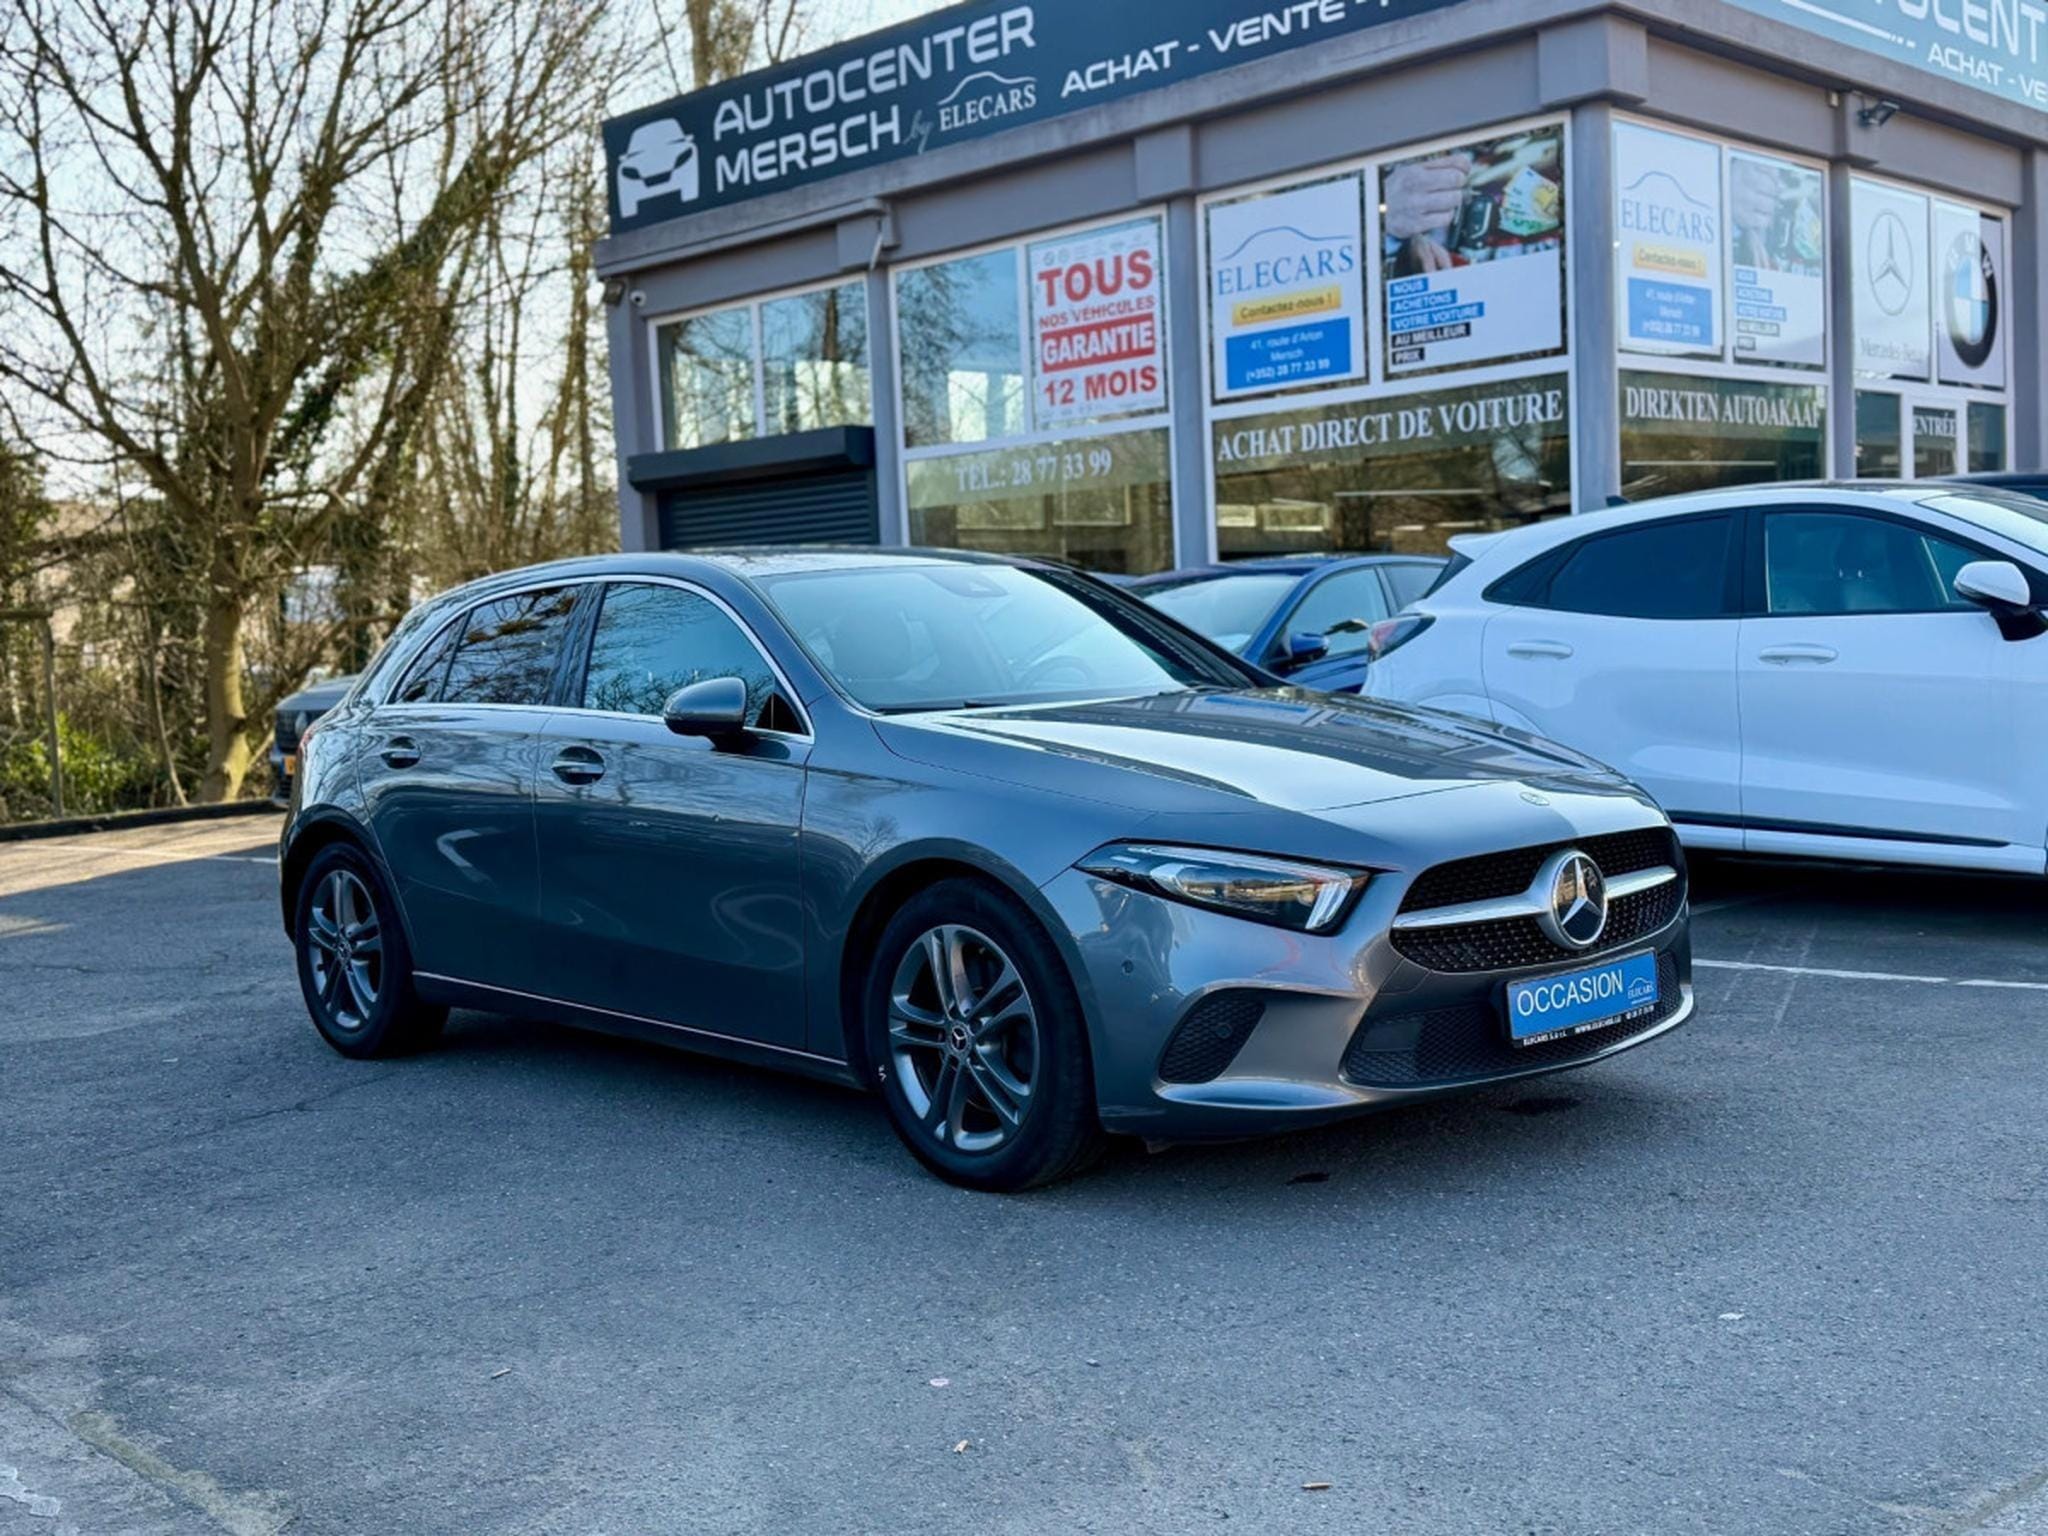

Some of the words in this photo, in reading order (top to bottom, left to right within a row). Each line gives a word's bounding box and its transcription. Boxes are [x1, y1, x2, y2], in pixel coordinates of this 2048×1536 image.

[1061, 41, 1179, 98] ACHAT
[1208, 0, 1345, 52] VENTE
[1928, 42, 2004, 86] ACHAT
[713, 6, 1036, 140] AUTOCENTER
[938, 85, 1036, 131] ELECARS
[715, 104, 900, 193] MERSCH
[1621, 198, 1714, 244] ELECARS
[1037, 249, 1153, 307] TOUS
[1217, 245, 1353, 295] ELECARS
[1040, 310, 1068, 328] NOS
[1043, 321, 1154, 365] GARANTIE
[1045, 379, 1075, 406] 12
[1085, 366, 1157, 401] MOIS
[1625, 386, 1719, 423] DIREKTEN
[1218, 425, 1295, 461] ACHAT
[1301, 412, 1393, 451] DIRECT
[1398, 407, 1434, 440] DE
[1438, 390, 1563, 434] VOITURE
[1012, 460, 1032, 486] 28
[1036, 456, 1057, 482] 77
[1064, 452, 1084, 480] 33
[1089, 448, 1112, 477] 99
[1517, 969, 1623, 1017] OCCASION
